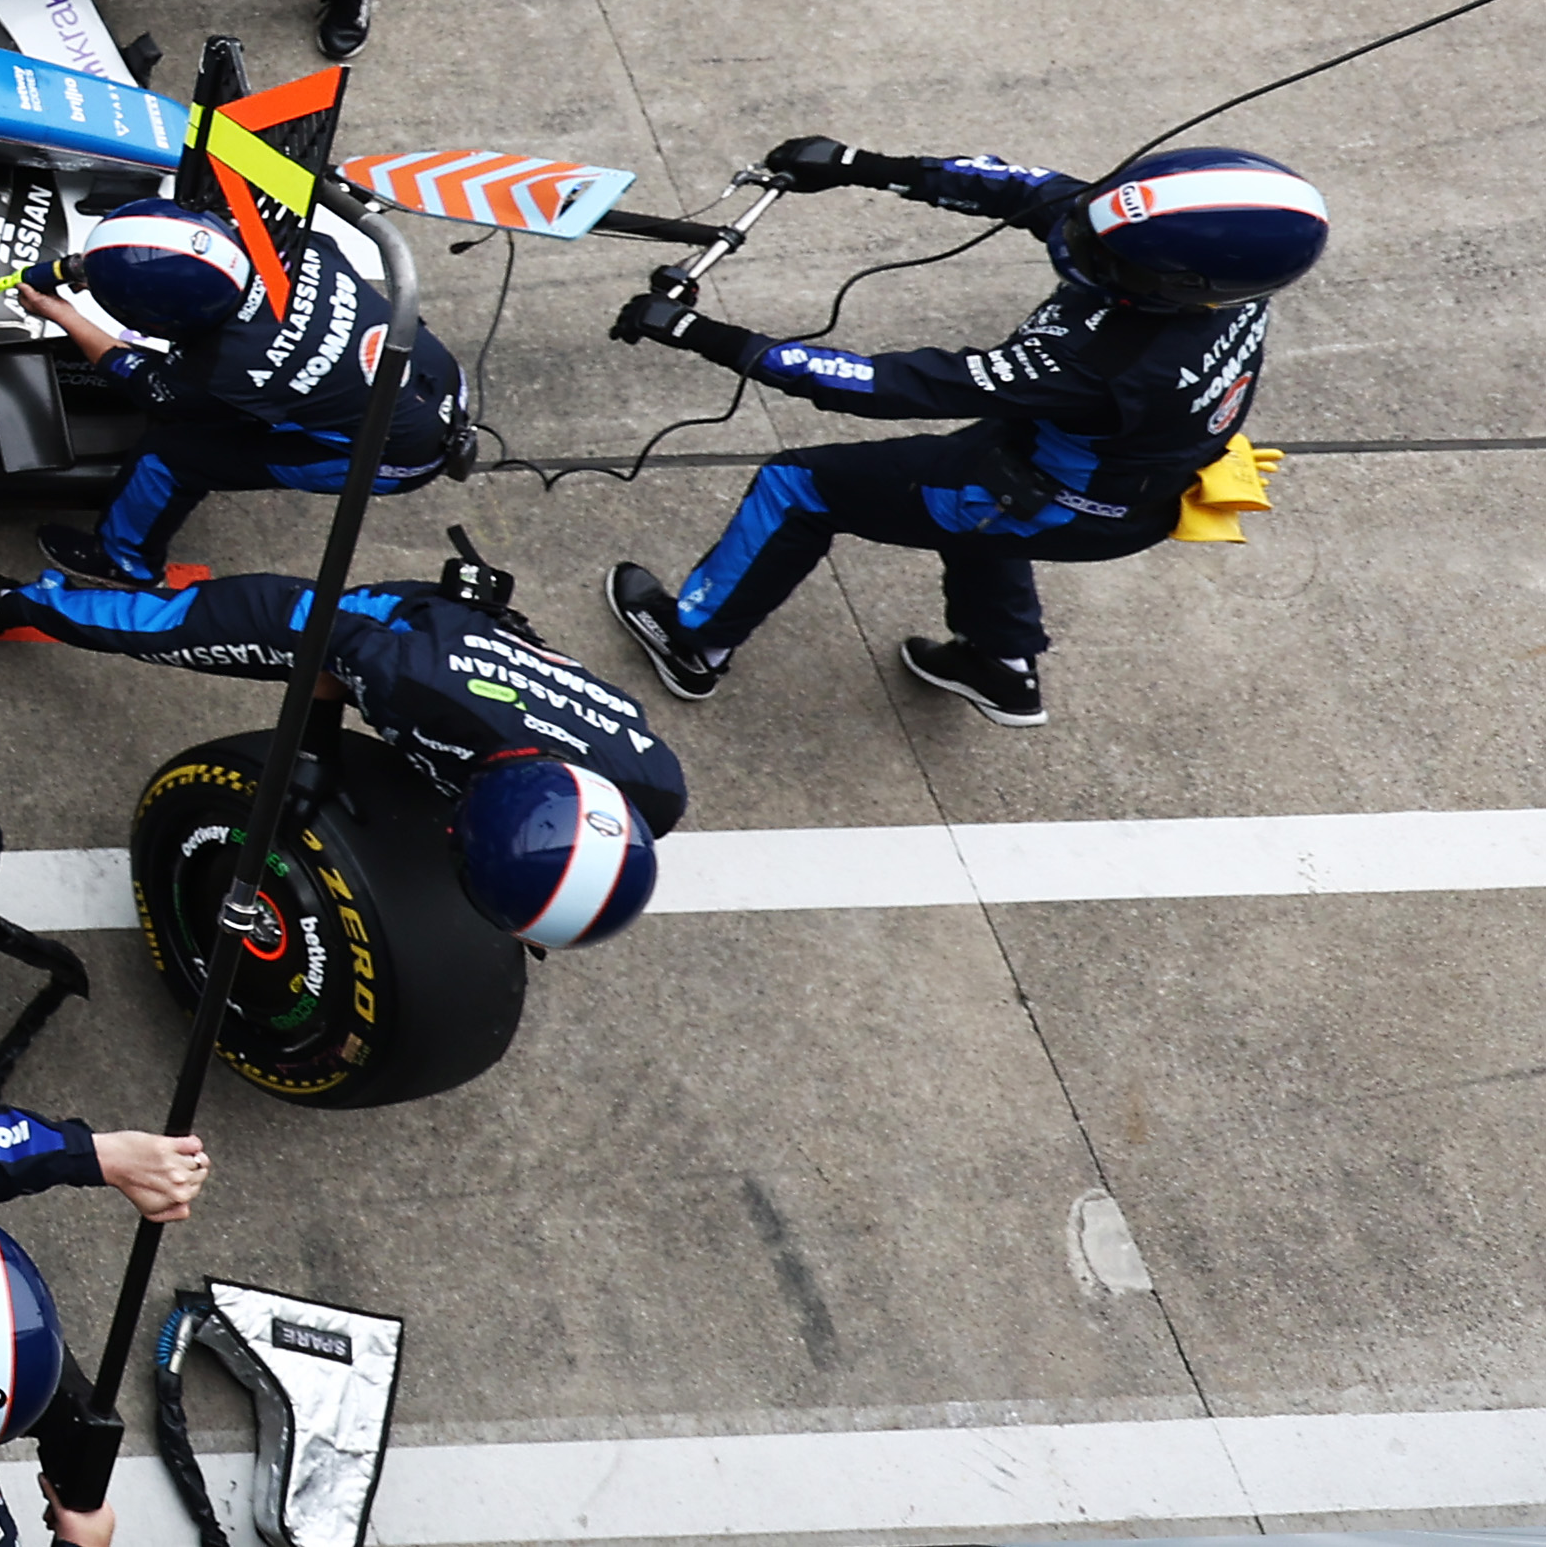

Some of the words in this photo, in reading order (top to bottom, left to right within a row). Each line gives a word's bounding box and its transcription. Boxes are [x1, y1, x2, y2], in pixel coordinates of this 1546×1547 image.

[14, 65, 32, 111] betway
[27, 67, 43, 112] SCORES
[144, 93, 171, 150] PIRELLI
[1121, 184, 1146, 222] Gulf
[264, 247, 320, 370] ATLASSIAN
[287, 271, 359, 397] KOMATSU
[448, 653, 621, 736] ATLASSIAN
[462, 633, 640, 719] KOMATSU
[299, 915, 328, 997] betway
[318, 866, 377, 1025] ZERO
[281, 1325, 347, 1359] SPARE
